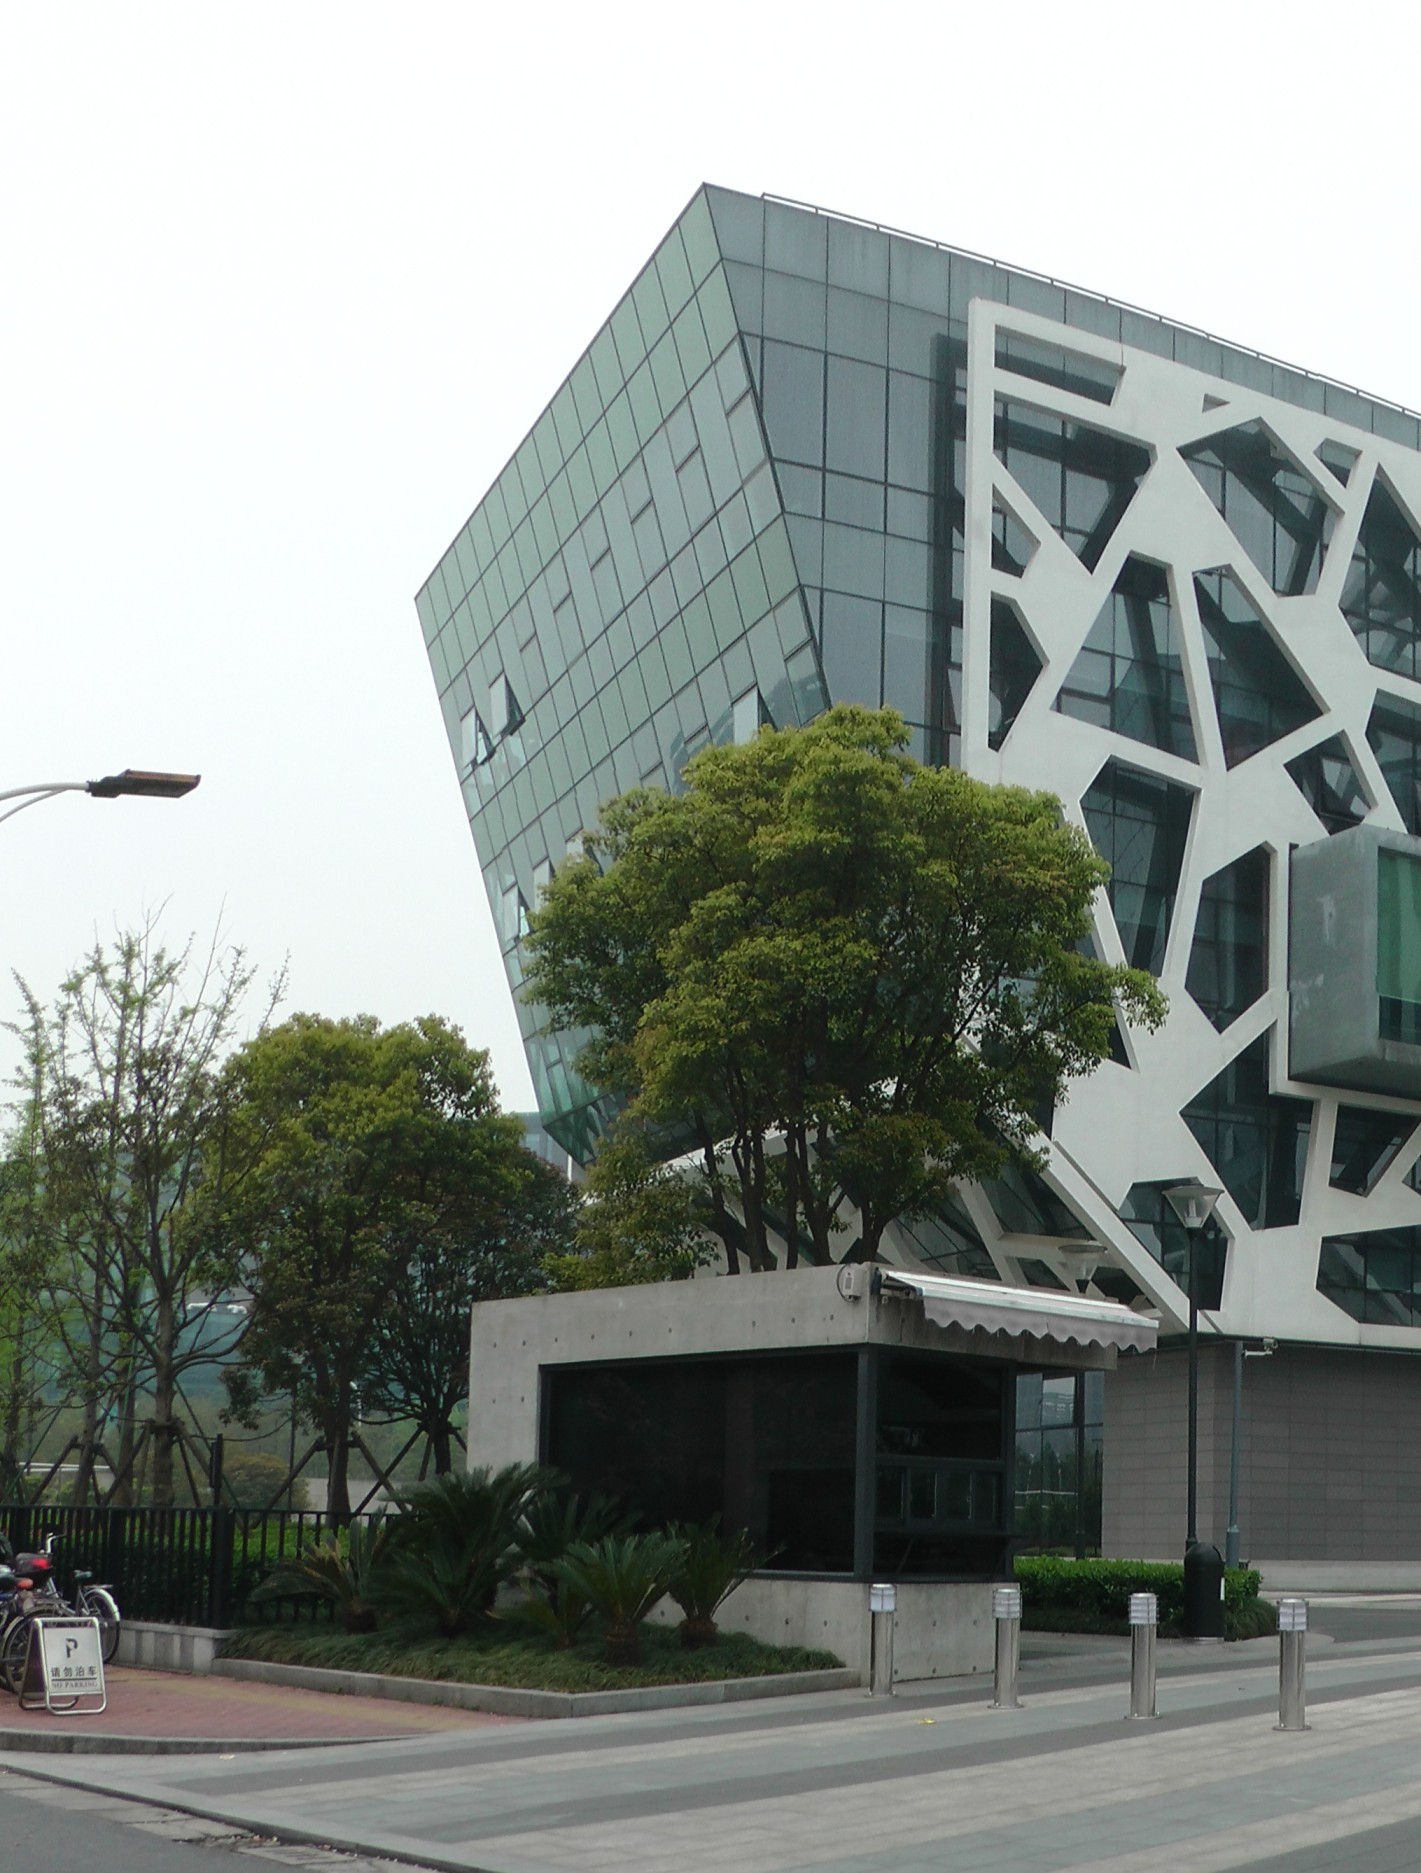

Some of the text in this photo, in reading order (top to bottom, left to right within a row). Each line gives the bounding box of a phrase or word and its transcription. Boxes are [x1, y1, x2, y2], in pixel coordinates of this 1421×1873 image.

[66, 1638, 78, 1658] P
[51, 1666, 96, 1677] 请勿泊车
